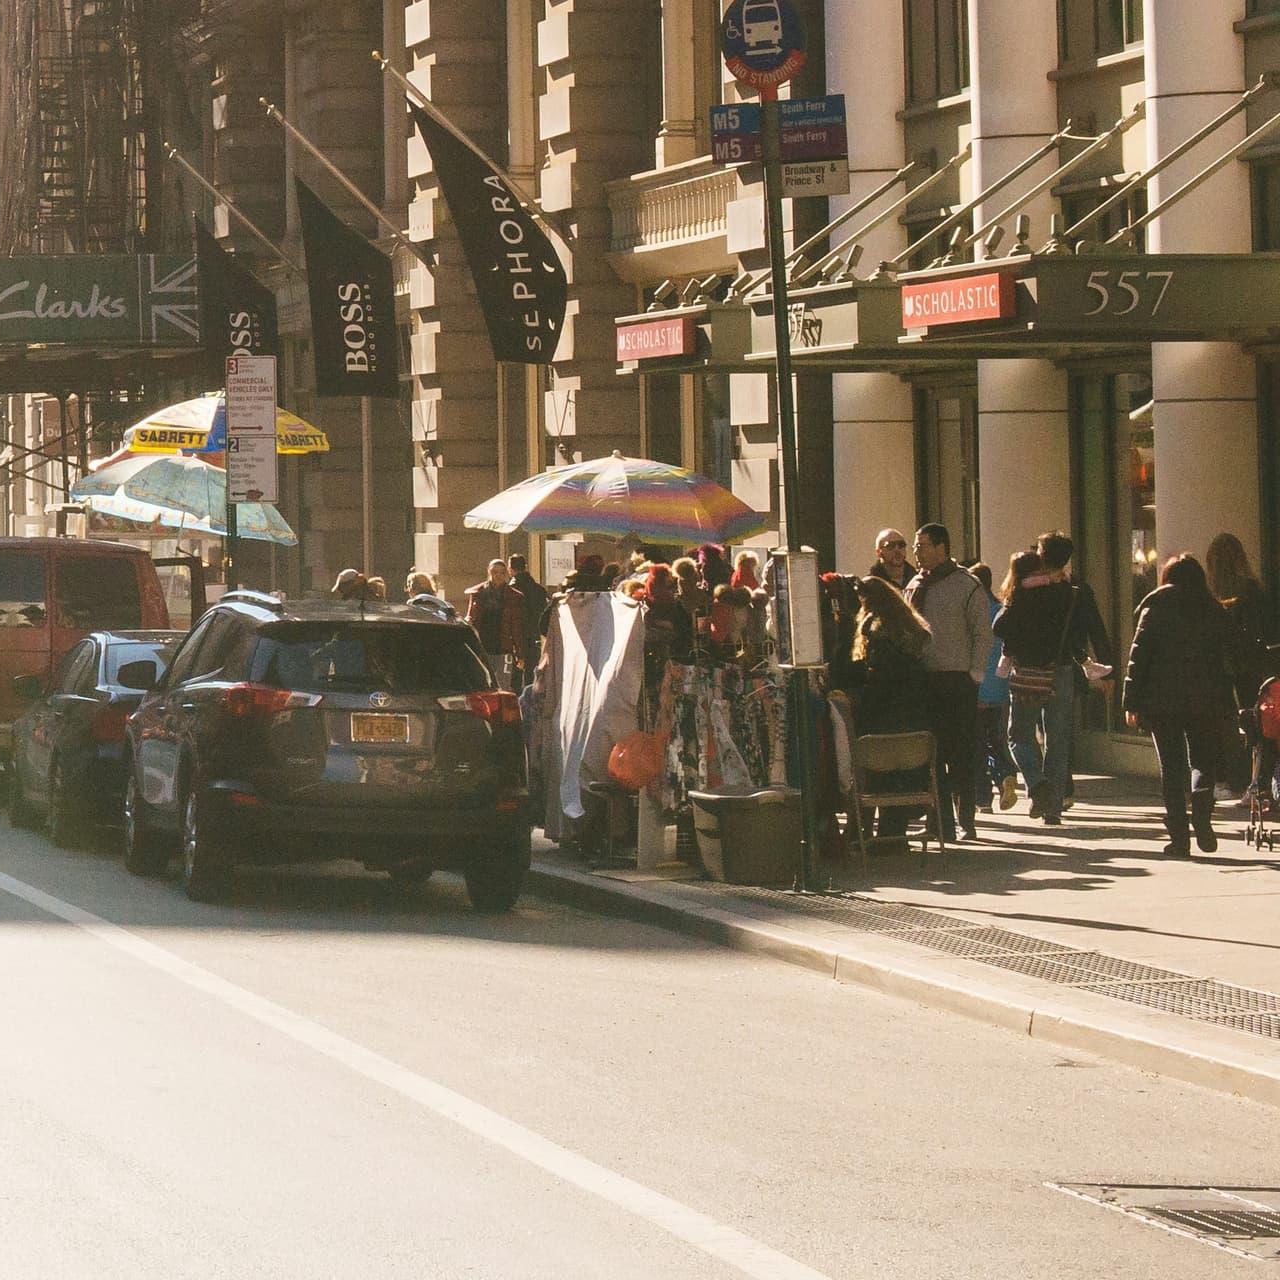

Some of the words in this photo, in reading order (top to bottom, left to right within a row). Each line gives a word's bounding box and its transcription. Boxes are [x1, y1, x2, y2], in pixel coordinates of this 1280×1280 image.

[732, 63, 747, 78] NO
[750, 55, 797, 83] STANDING
[806, 101, 826, 113] Ferry
[713, 108, 740, 130] M5
[782, 133, 804, 144] South
[806, 131, 827, 144] Ferry
[715, 138, 742, 160] M5
[784, 165, 826, 175] Broadway
[830, 163, 836, 173] &
[785, 176, 811, 187] Prince
[484, 175, 542, 351] SEPHORA
[914, 283, 998, 317] SCHOLASTIC
[1083, 271, 1174, 316] 557
[337, 283, 369, 375] BOSS
[624, 324, 683, 353] SCHOLASTIC
[368, 332, 377, 372] HUGO
[228, 359, 237, 374] 3
[228, 377, 267, 385] COMMERCIAL
[228, 385, 257, 393] VEHICLES
[139, 429, 206, 444] SABRETT
[277, 433, 325, 448] SABRETT
[229, 438, 238, 452] 2
